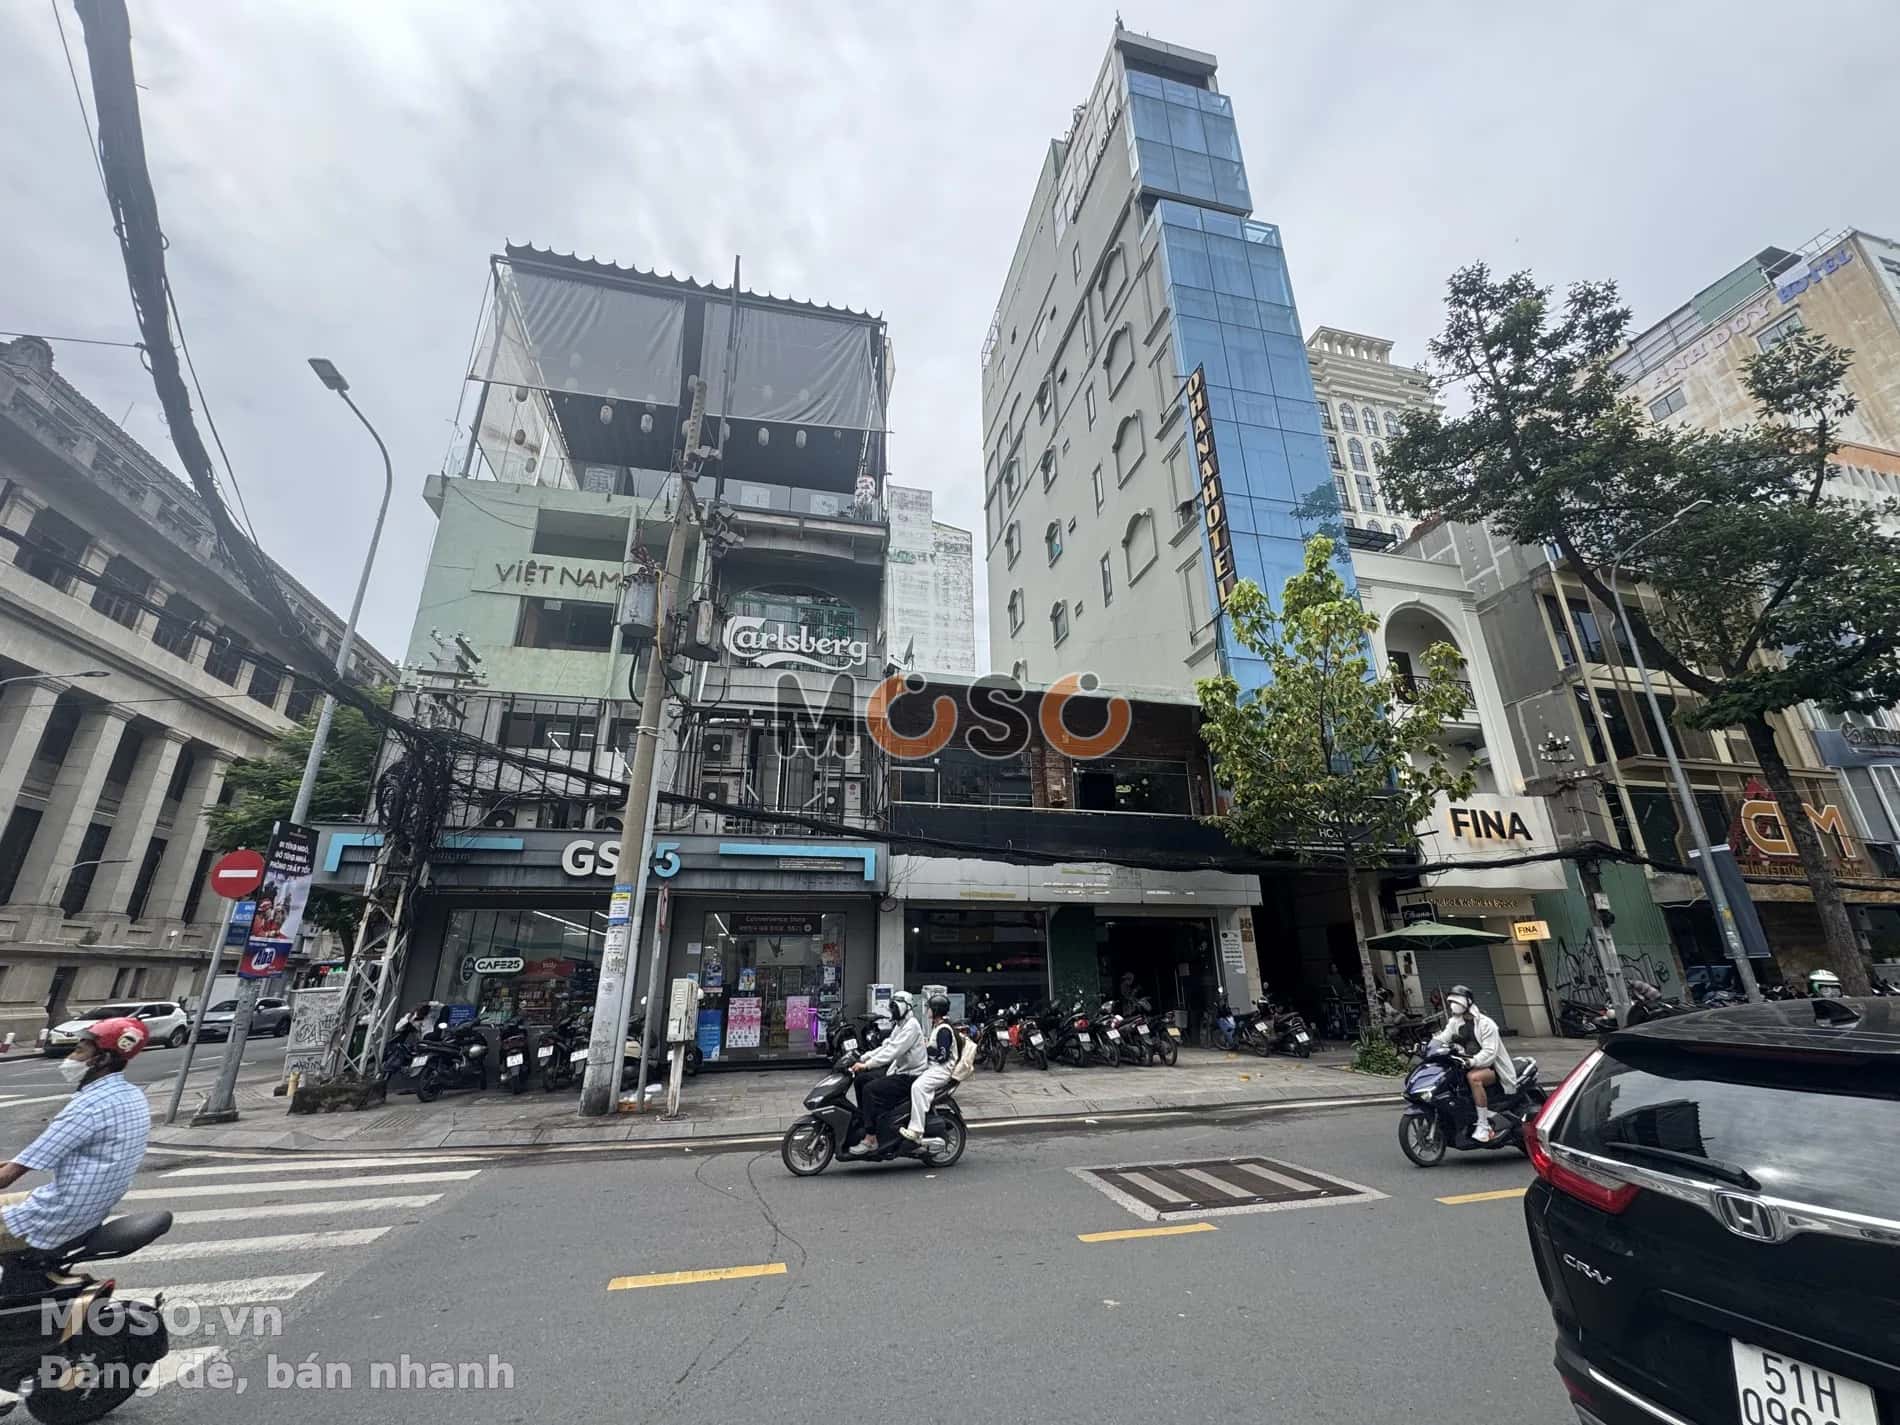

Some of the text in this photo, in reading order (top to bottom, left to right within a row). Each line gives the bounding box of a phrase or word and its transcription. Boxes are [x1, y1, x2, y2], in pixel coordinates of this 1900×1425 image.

[496, 559, 621, 590] VIỆT NAM
[722, 615, 868, 666] Carlsberg
[1450, 807, 1534, 841] FINA
[561, 839, 681, 878] GS5
[1518, 925, 1538, 934] FINA
[477, 960, 521, 970] CAFE25
[1762, 1351, 1841, 1419] 51H
[1742, 1388, 1841, 1425] 09
